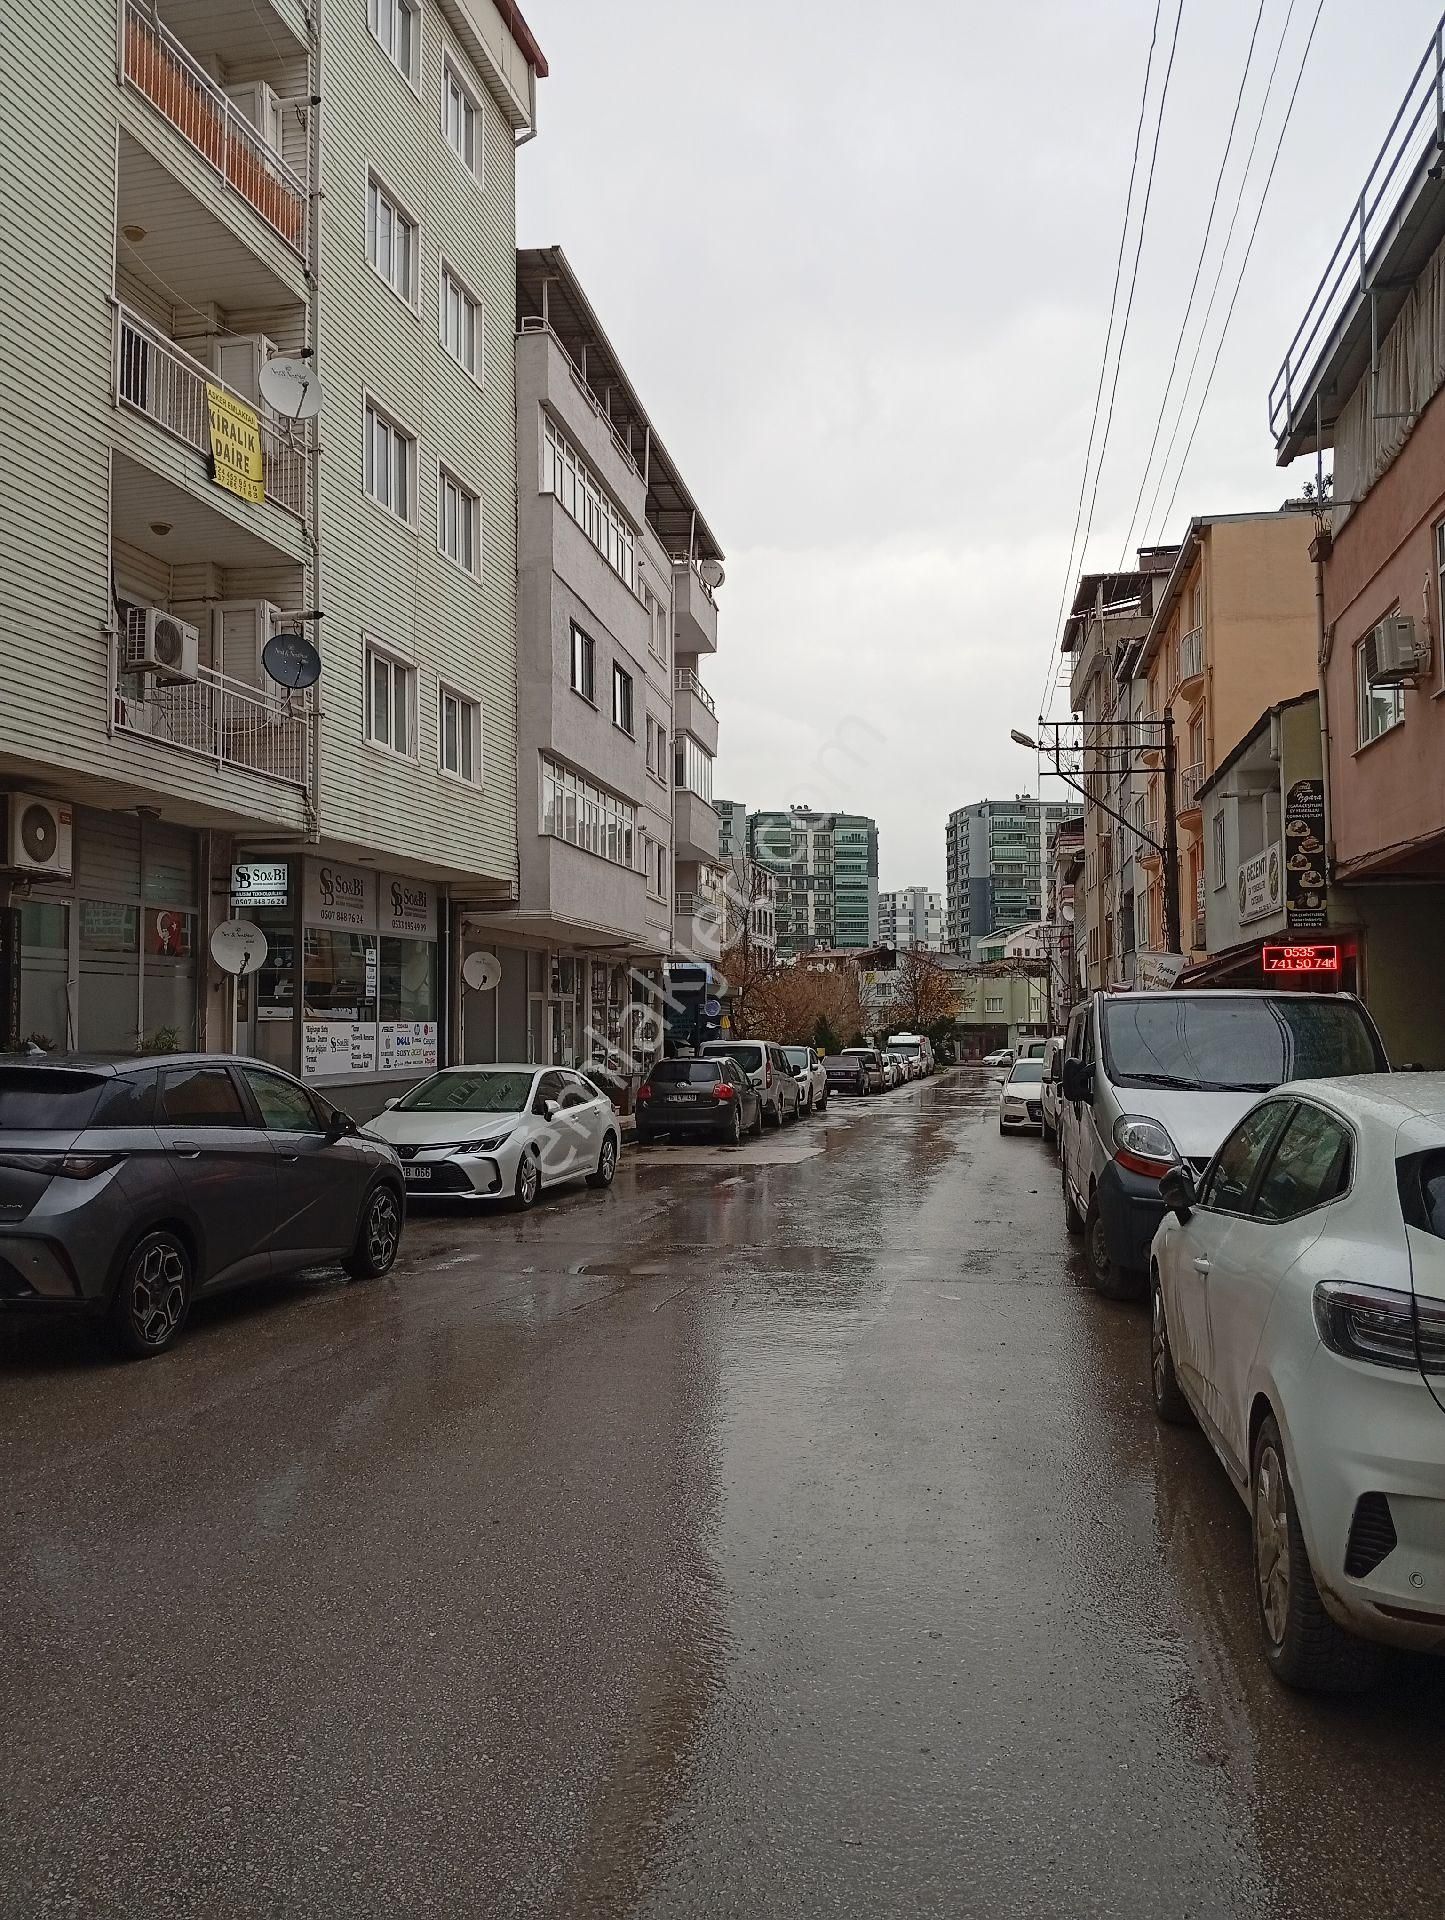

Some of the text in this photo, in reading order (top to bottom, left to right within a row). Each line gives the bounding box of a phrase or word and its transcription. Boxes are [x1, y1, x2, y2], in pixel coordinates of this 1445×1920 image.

[208, 389, 227, 408] ASKER
[210, 409, 255, 453] KİRALIK
[216, 438, 250, 474] DAİRE
[252, 868, 286, 881] So&Bi
[336, 874, 364, 897] So&Bi
[404, 888, 427, 908] So&Bi
[320, 909, 335, 920] 0507
[336, 910, 348, 922] 848
[1284, 948, 1315, 957] 0535
[1270, 960, 1293, 968] 741
[1296, 958, 1312, 968] 50
[396, 1036, 410, 1046] DELL
[414, 1168, 430, 1178] 066
